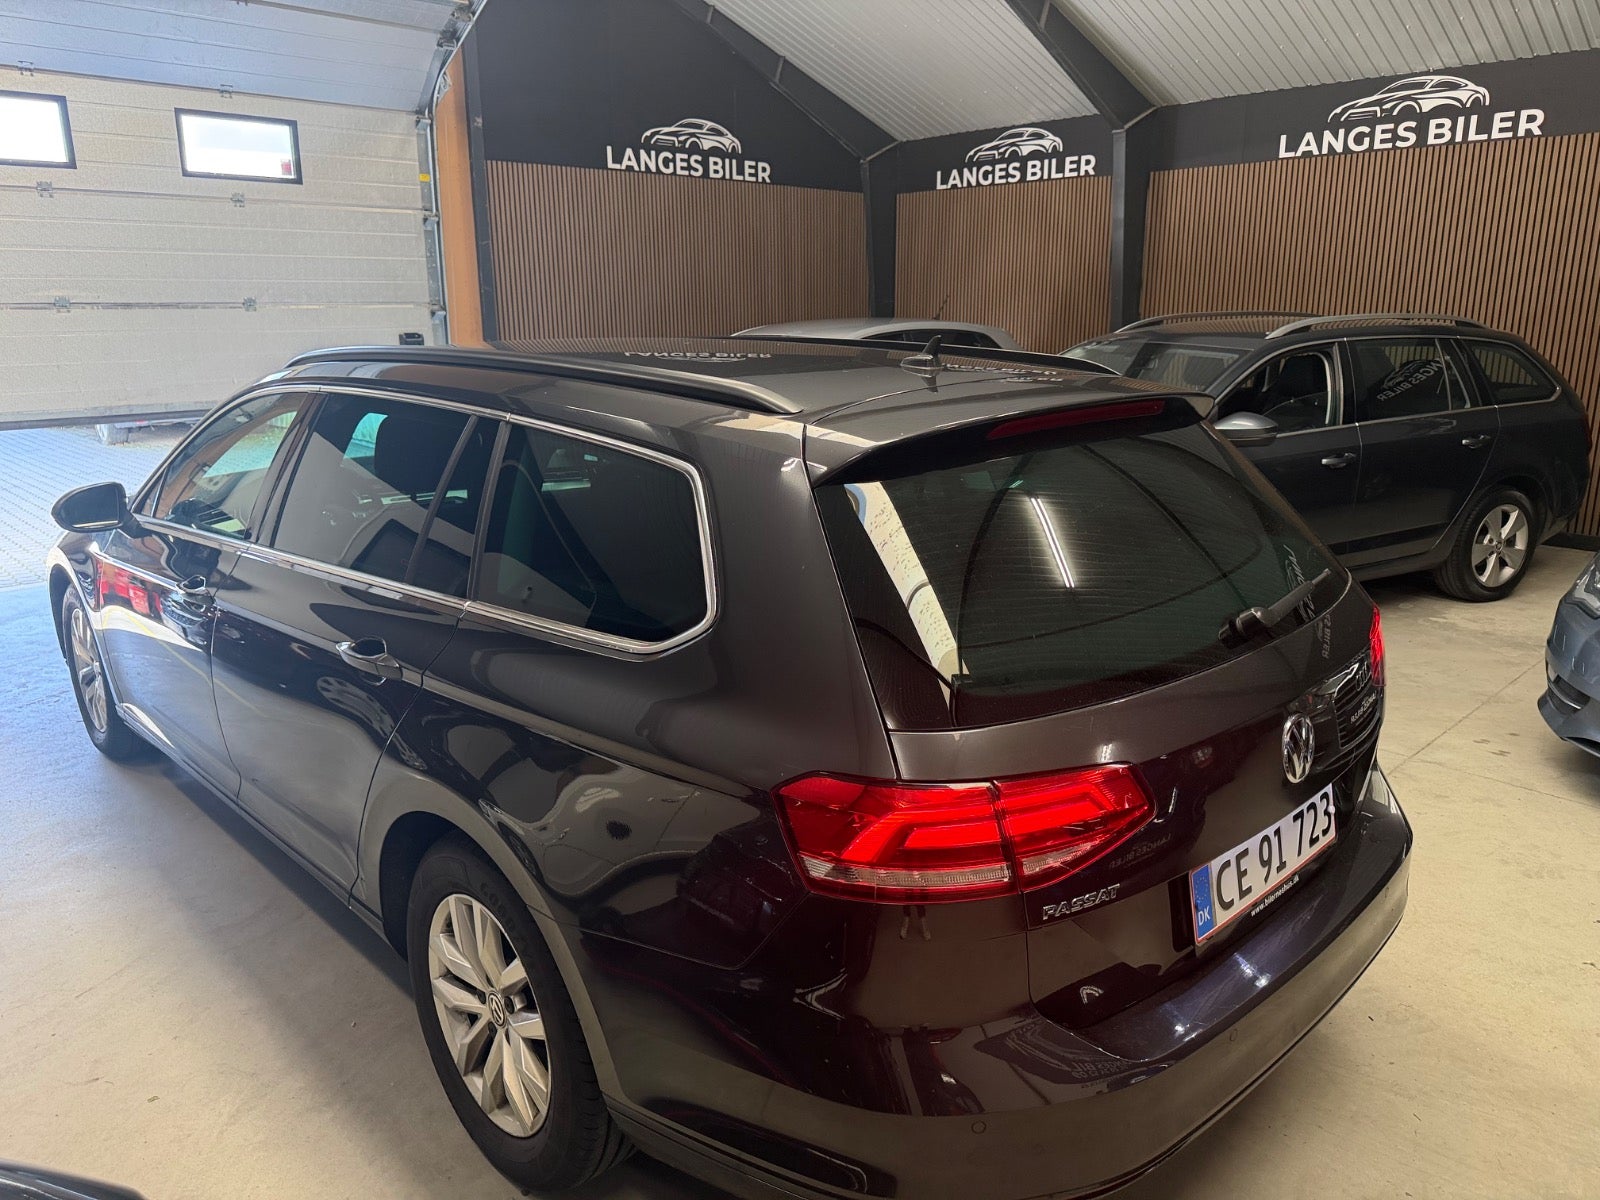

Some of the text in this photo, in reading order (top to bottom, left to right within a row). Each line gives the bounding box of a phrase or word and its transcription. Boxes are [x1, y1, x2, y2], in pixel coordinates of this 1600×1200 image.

[1278, 108, 1546, 159] LANGES BILER
[606, 145, 771, 183] LANGES BILER
[936, 154, 1097, 190] LANGES BILER
[1216, 791, 1332, 911] CE 91 723
[1042, 883, 1121, 920] PASSAT
[1198, 905, 1211, 926] DK
